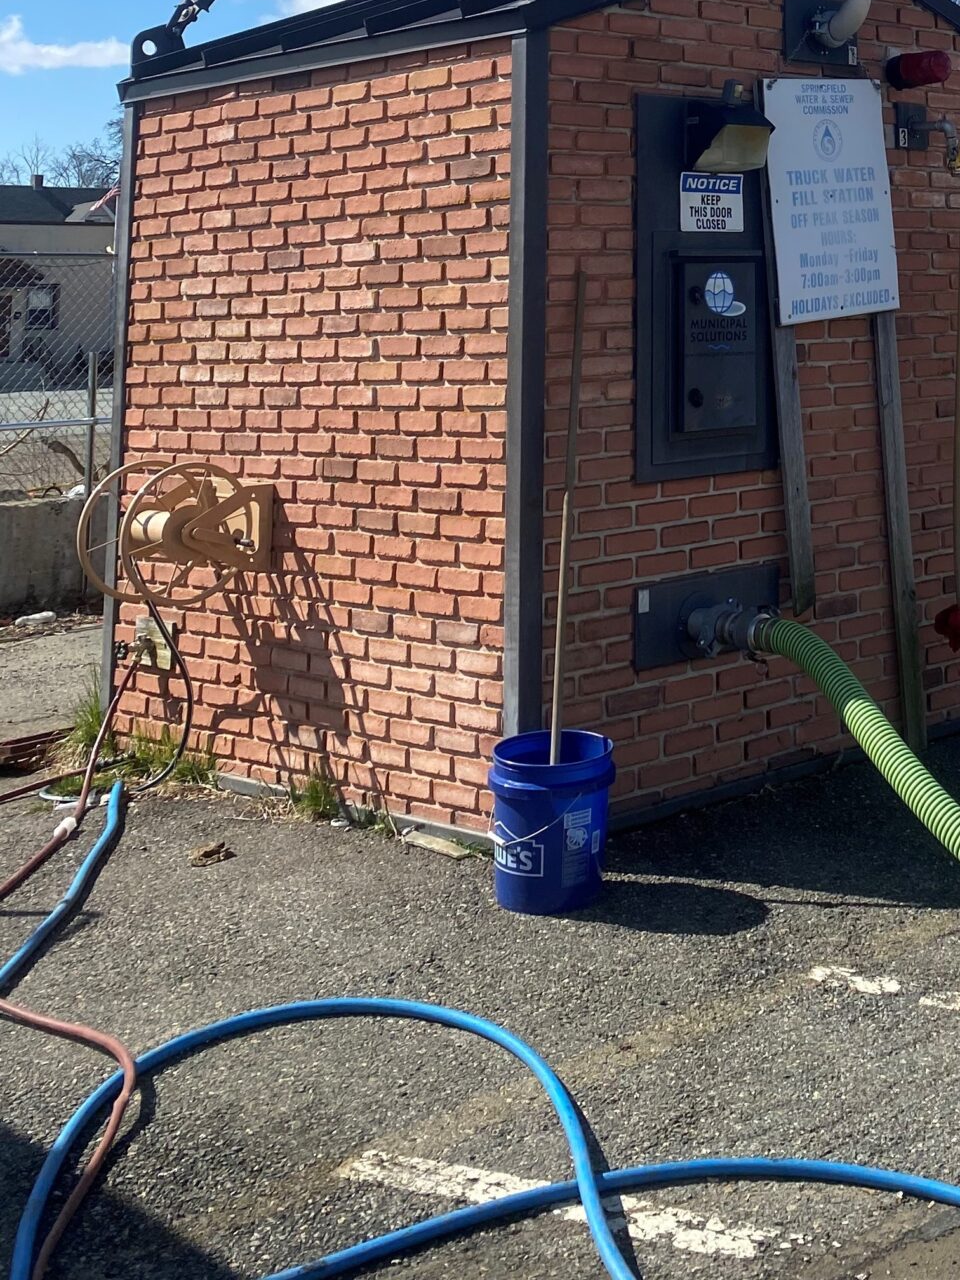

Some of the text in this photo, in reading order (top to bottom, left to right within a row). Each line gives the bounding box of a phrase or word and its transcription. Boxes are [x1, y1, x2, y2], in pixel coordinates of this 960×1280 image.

[801, 84, 847, 94] SPRINGFIELD
[795, 94, 854, 104] WATER & SEWER
[802, 105, 849, 115] COMMISSION
[900, 129, 907, 146] 3
[786, 166, 876, 186] TRUCK WATER
[686, 177, 738, 191] NOTICE
[701, 194, 721, 205] KEEP
[792, 186, 874, 207] FILL STATION
[689, 206, 732, 218] THIS DOOR
[790, 207, 880, 229] OFF PEAK SEASON
[696, 219, 727, 230] CLOSED
[820, 229, 857, 247] HOURS:
[799, 250, 839, 269] Monday
[791, 288, 890, 316] HOLIDAYS EXCLUDED
[690, 318, 748, 330] MUNICIPAL
[690, 330, 748, 343] SOLUTIONS
